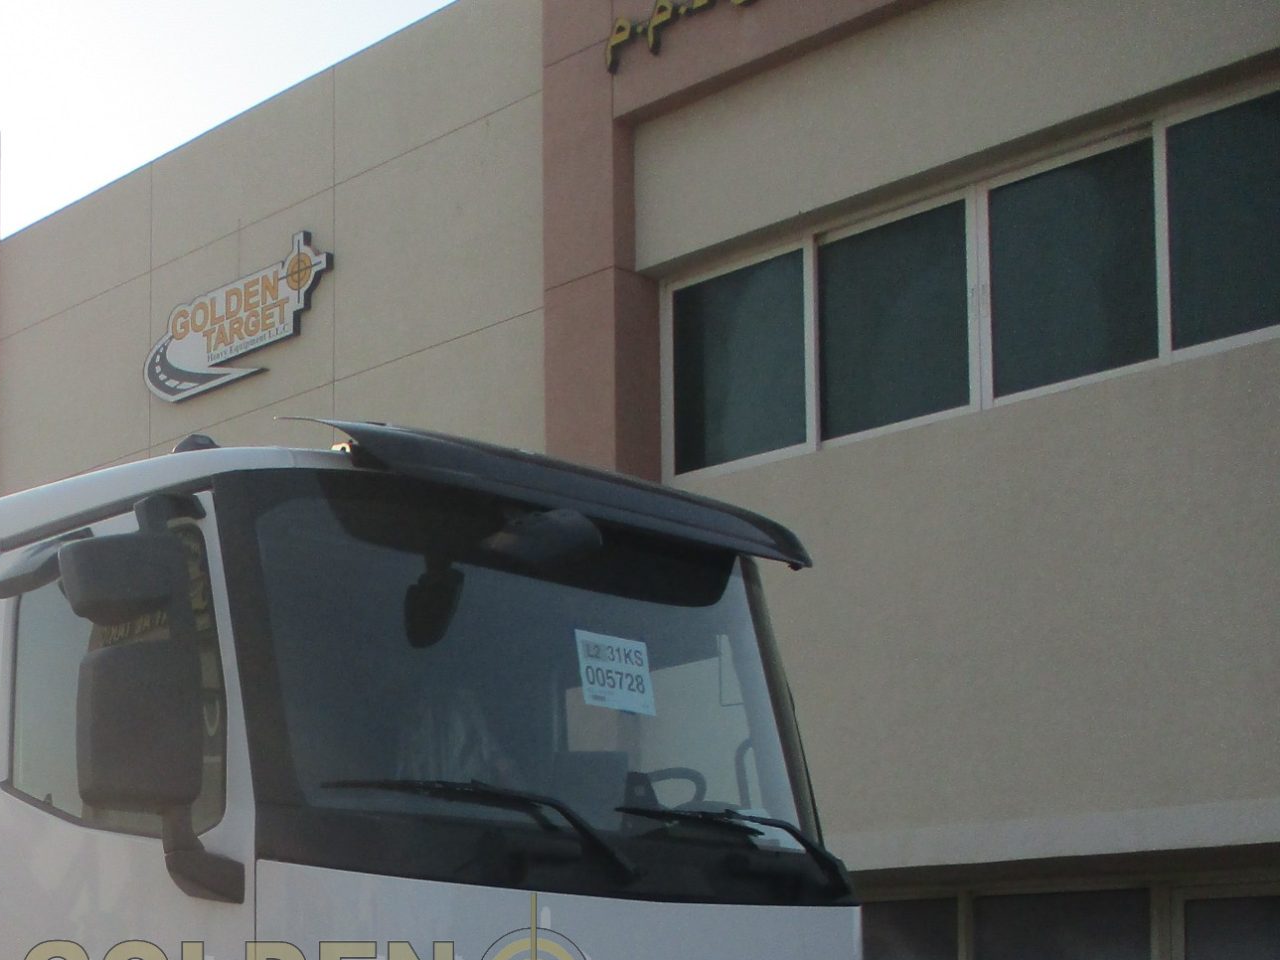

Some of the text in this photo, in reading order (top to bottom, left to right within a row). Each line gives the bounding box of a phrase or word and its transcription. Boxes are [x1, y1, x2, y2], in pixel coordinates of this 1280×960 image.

[172, 270, 280, 341] GOLDEN
[202, 297, 290, 354] TARGET
[585, 665, 646, 695] 005728
